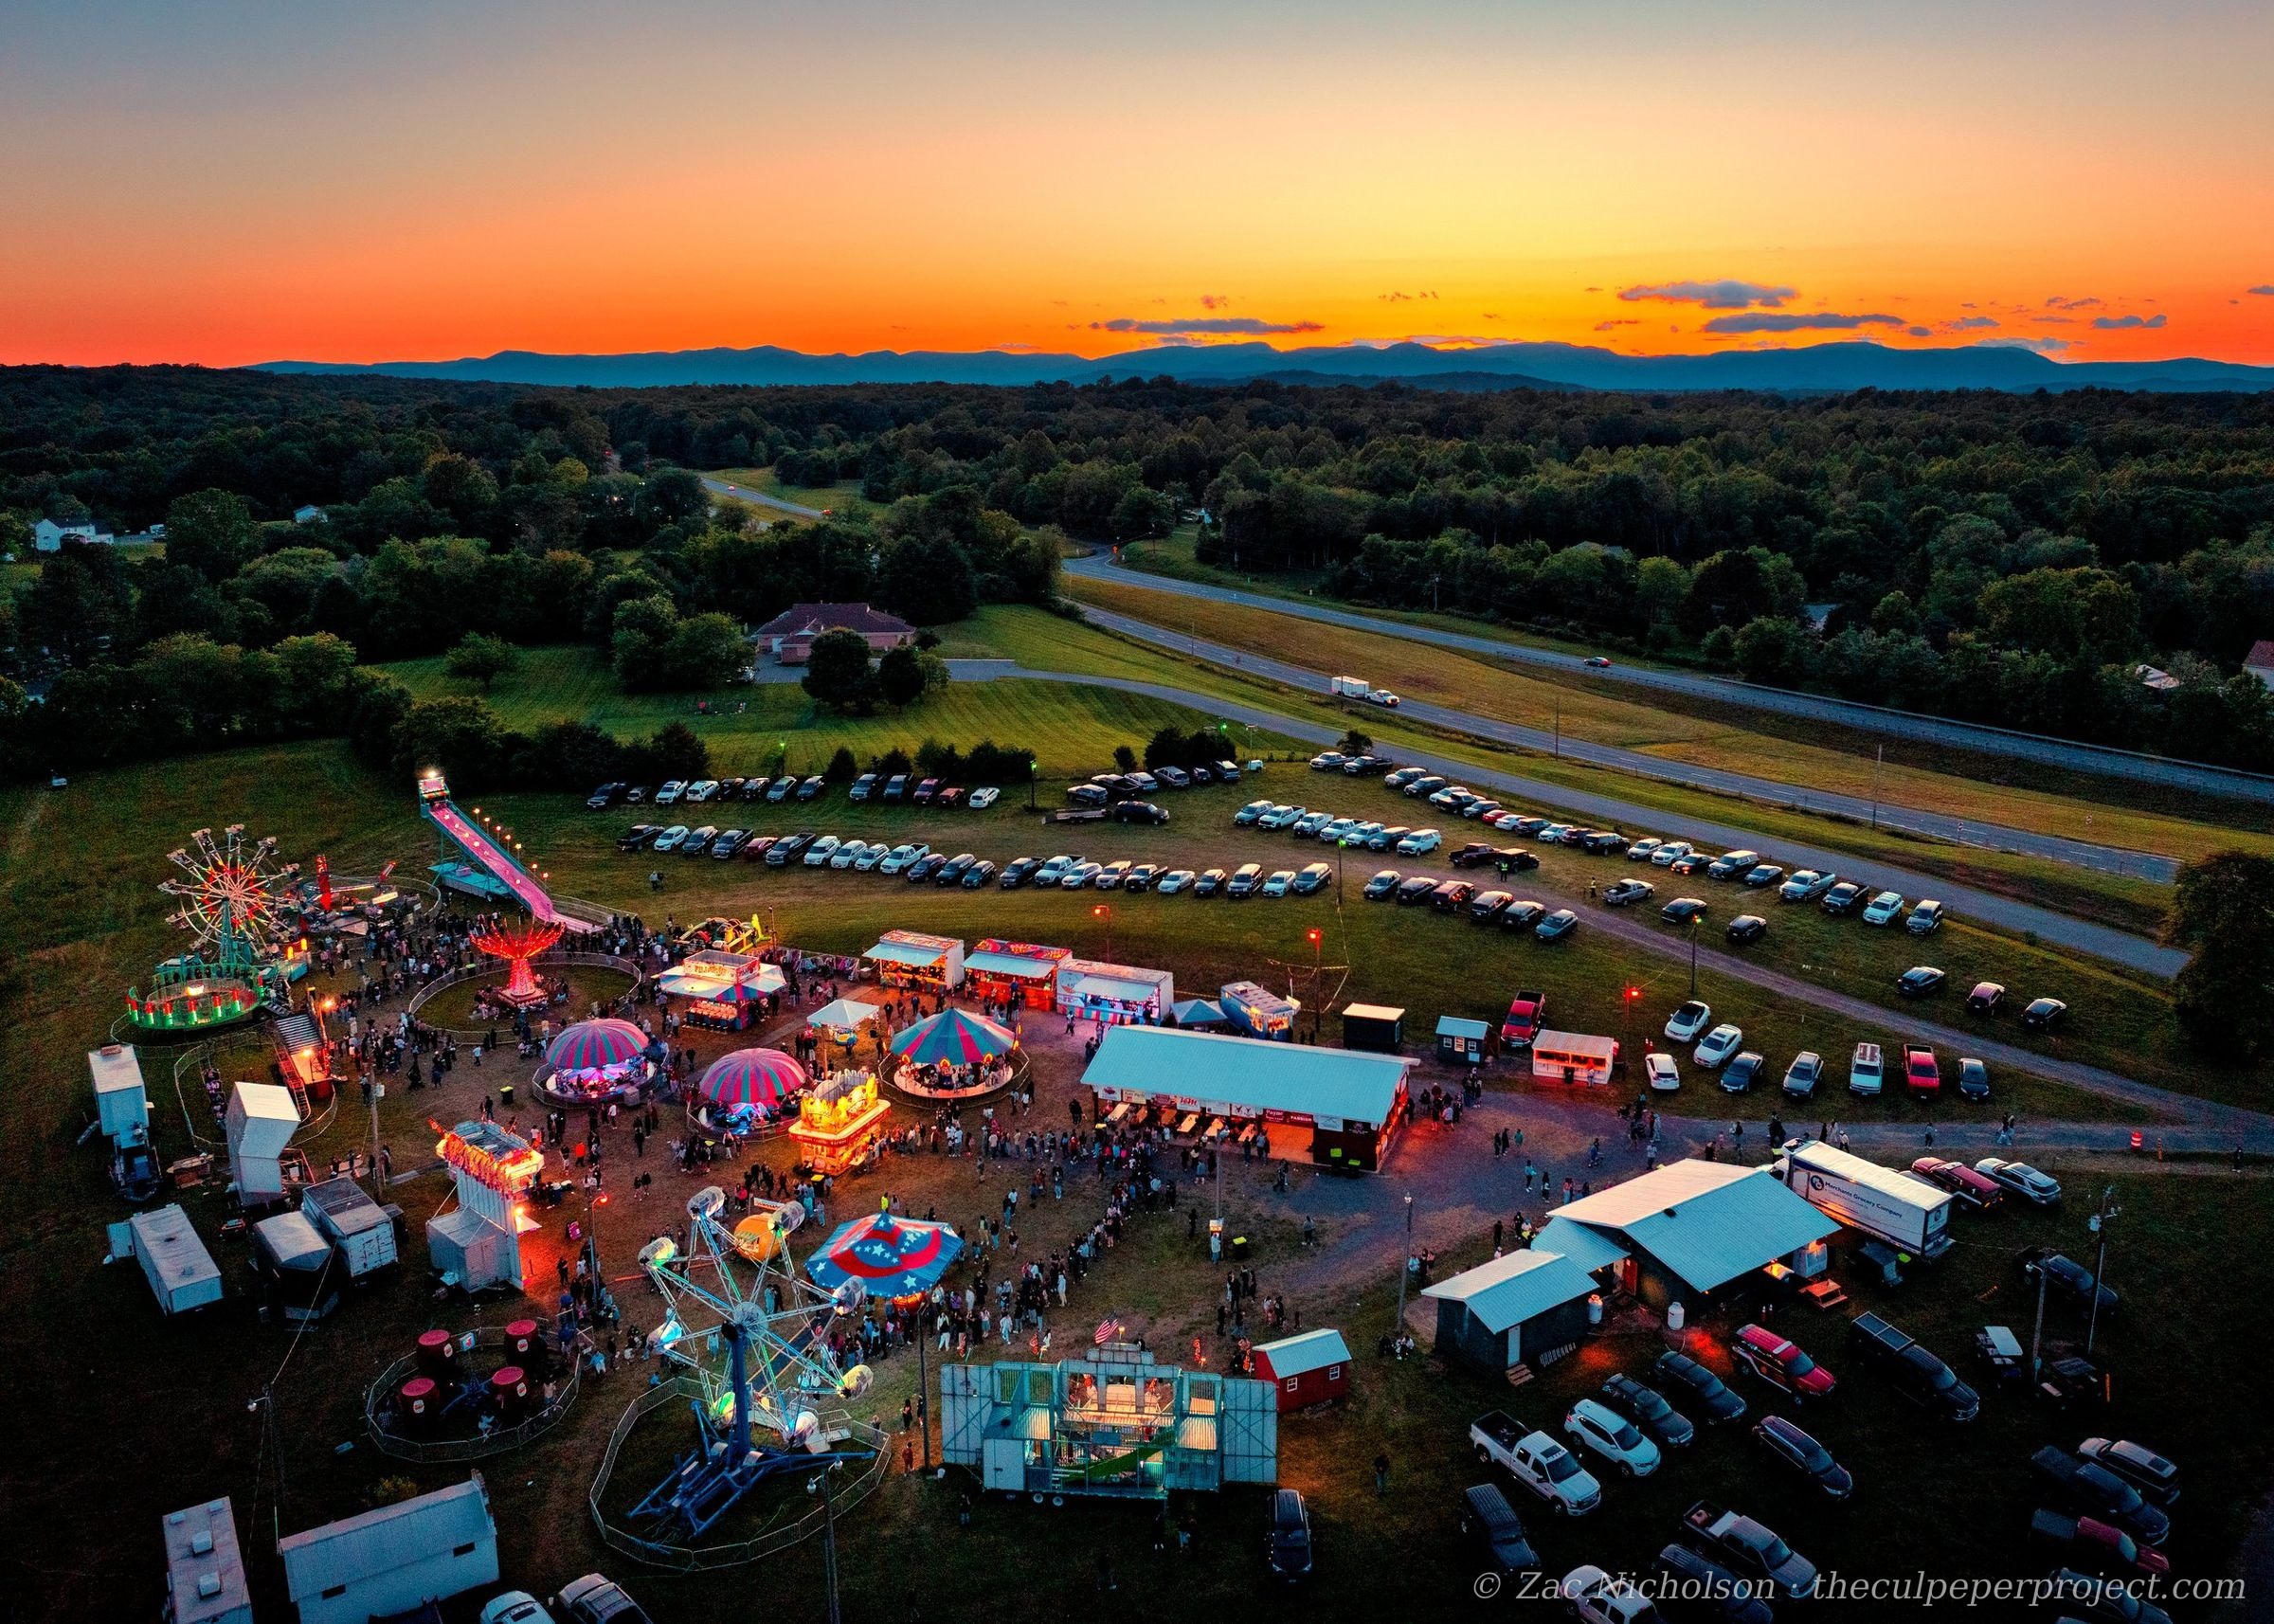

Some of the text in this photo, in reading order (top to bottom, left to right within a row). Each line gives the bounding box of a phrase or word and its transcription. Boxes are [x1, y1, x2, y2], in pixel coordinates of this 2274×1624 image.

[1825, 1182, 1852, 1196] Merchants
[1854, 1194, 1875, 1207] Grocery
[1877, 1204, 1903, 1218] Company
